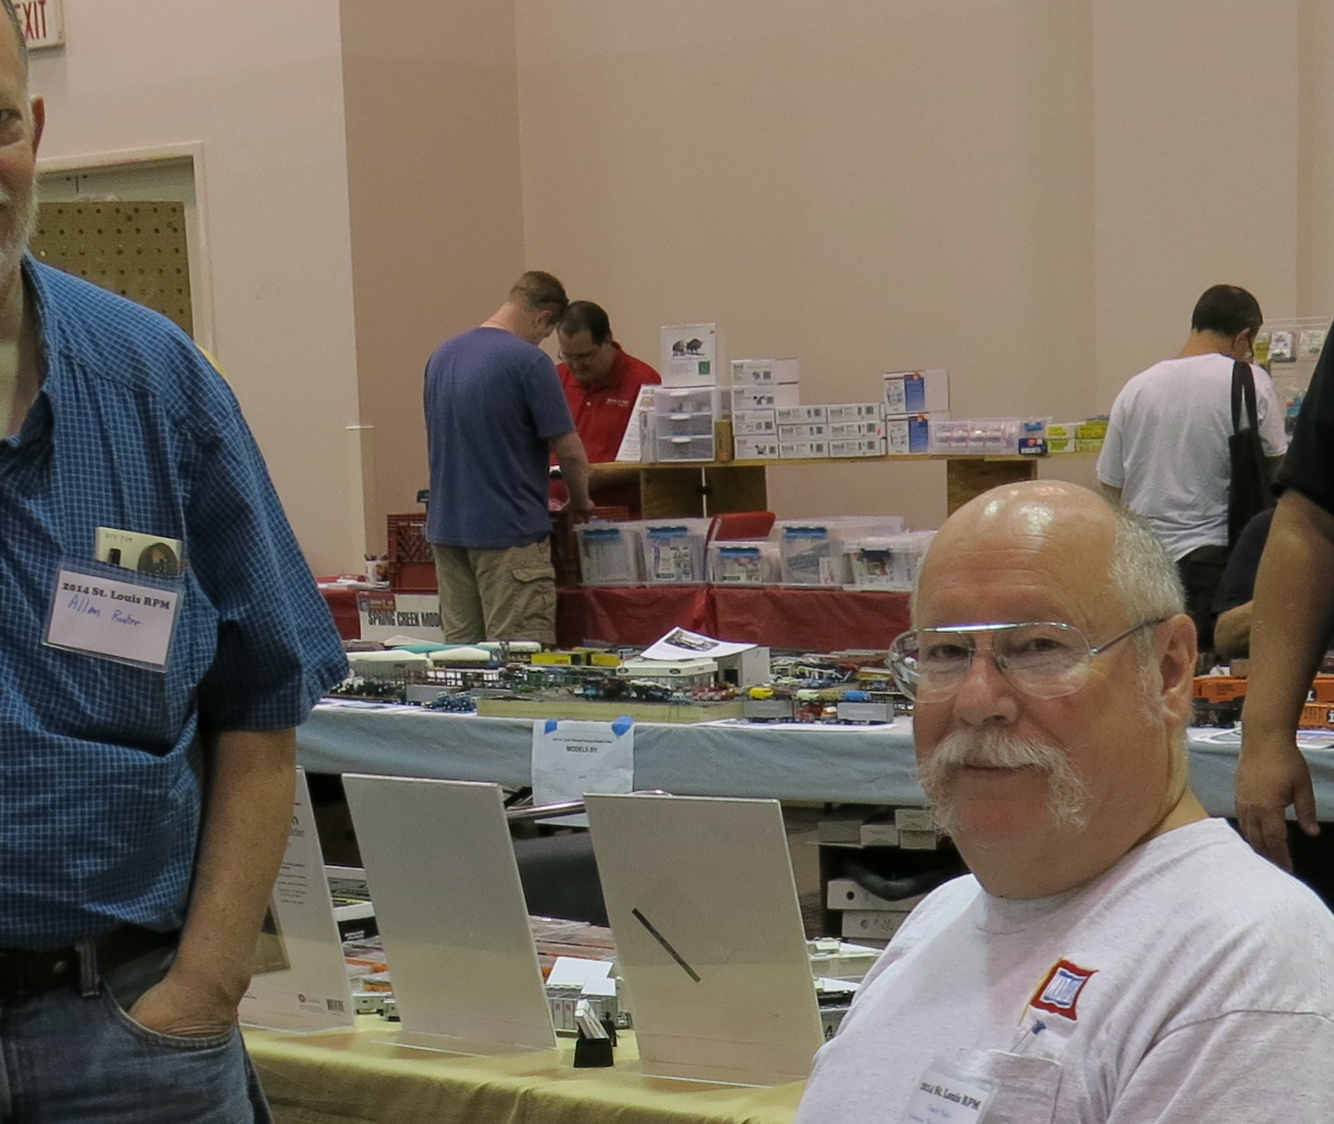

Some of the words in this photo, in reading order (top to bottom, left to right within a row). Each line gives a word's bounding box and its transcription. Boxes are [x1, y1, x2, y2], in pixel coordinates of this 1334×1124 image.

[14, 0, 47, 40] XIT
[63, 583, 89, 596] 2014
[92, 587, 107, 599] St.
[111, 591, 141, 605] Louis
[144, 596, 170, 610] RPM
[368, 610, 395, 625] SPRING
[397, 611, 420, 627] CREEK
